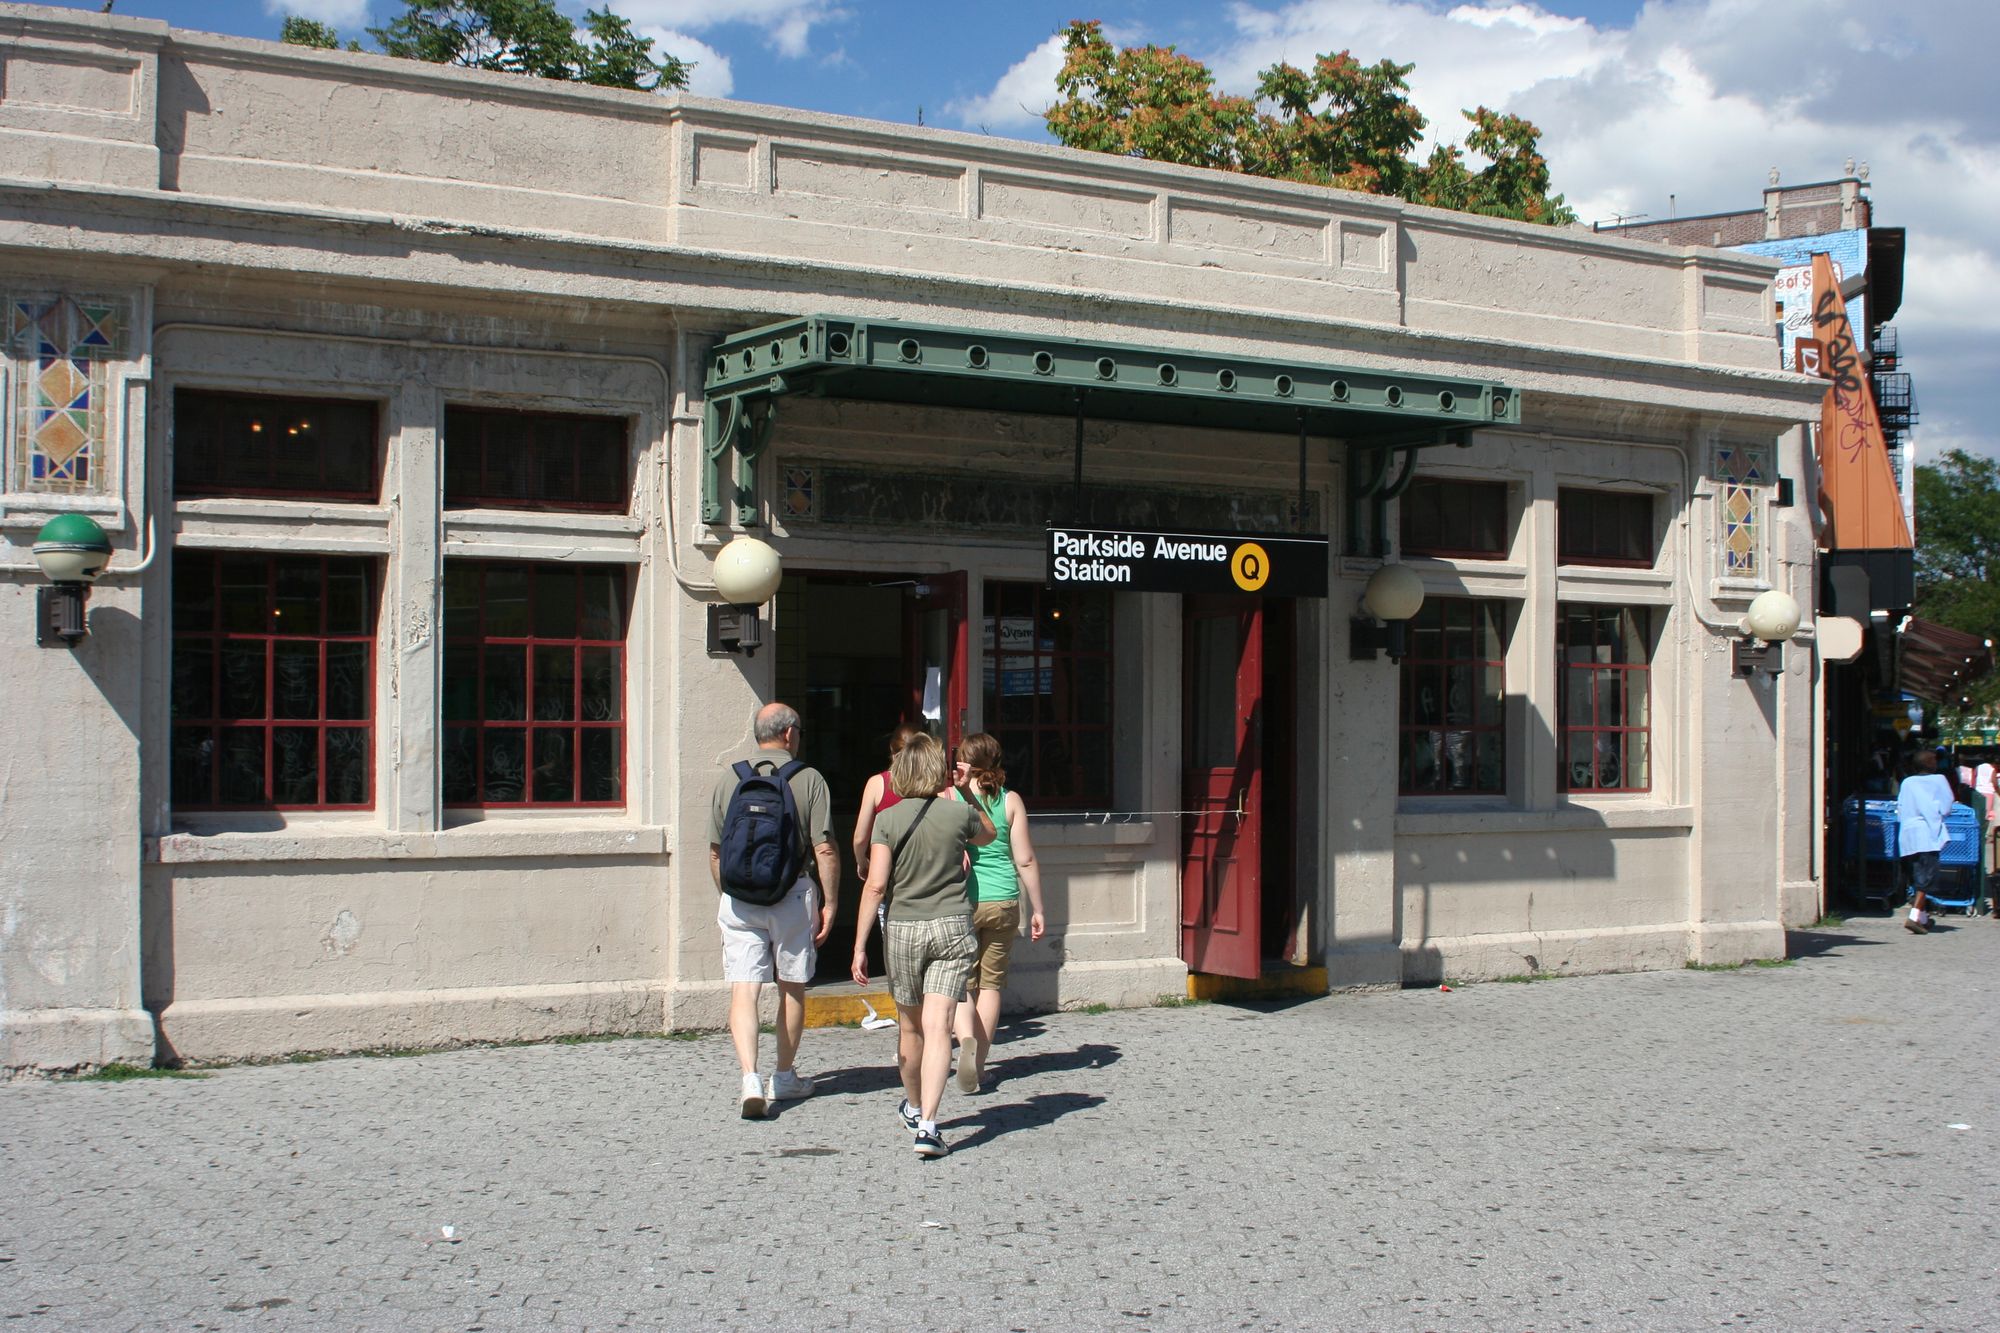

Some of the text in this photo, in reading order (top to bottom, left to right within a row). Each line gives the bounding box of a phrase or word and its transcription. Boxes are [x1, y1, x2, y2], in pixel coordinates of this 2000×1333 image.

[1786, 272, 1799, 289] of
[1053, 531, 1227, 562] Parkside Avenue
[1053, 556, 1131, 582] Station
[1240, 554, 1260, 580] Q
